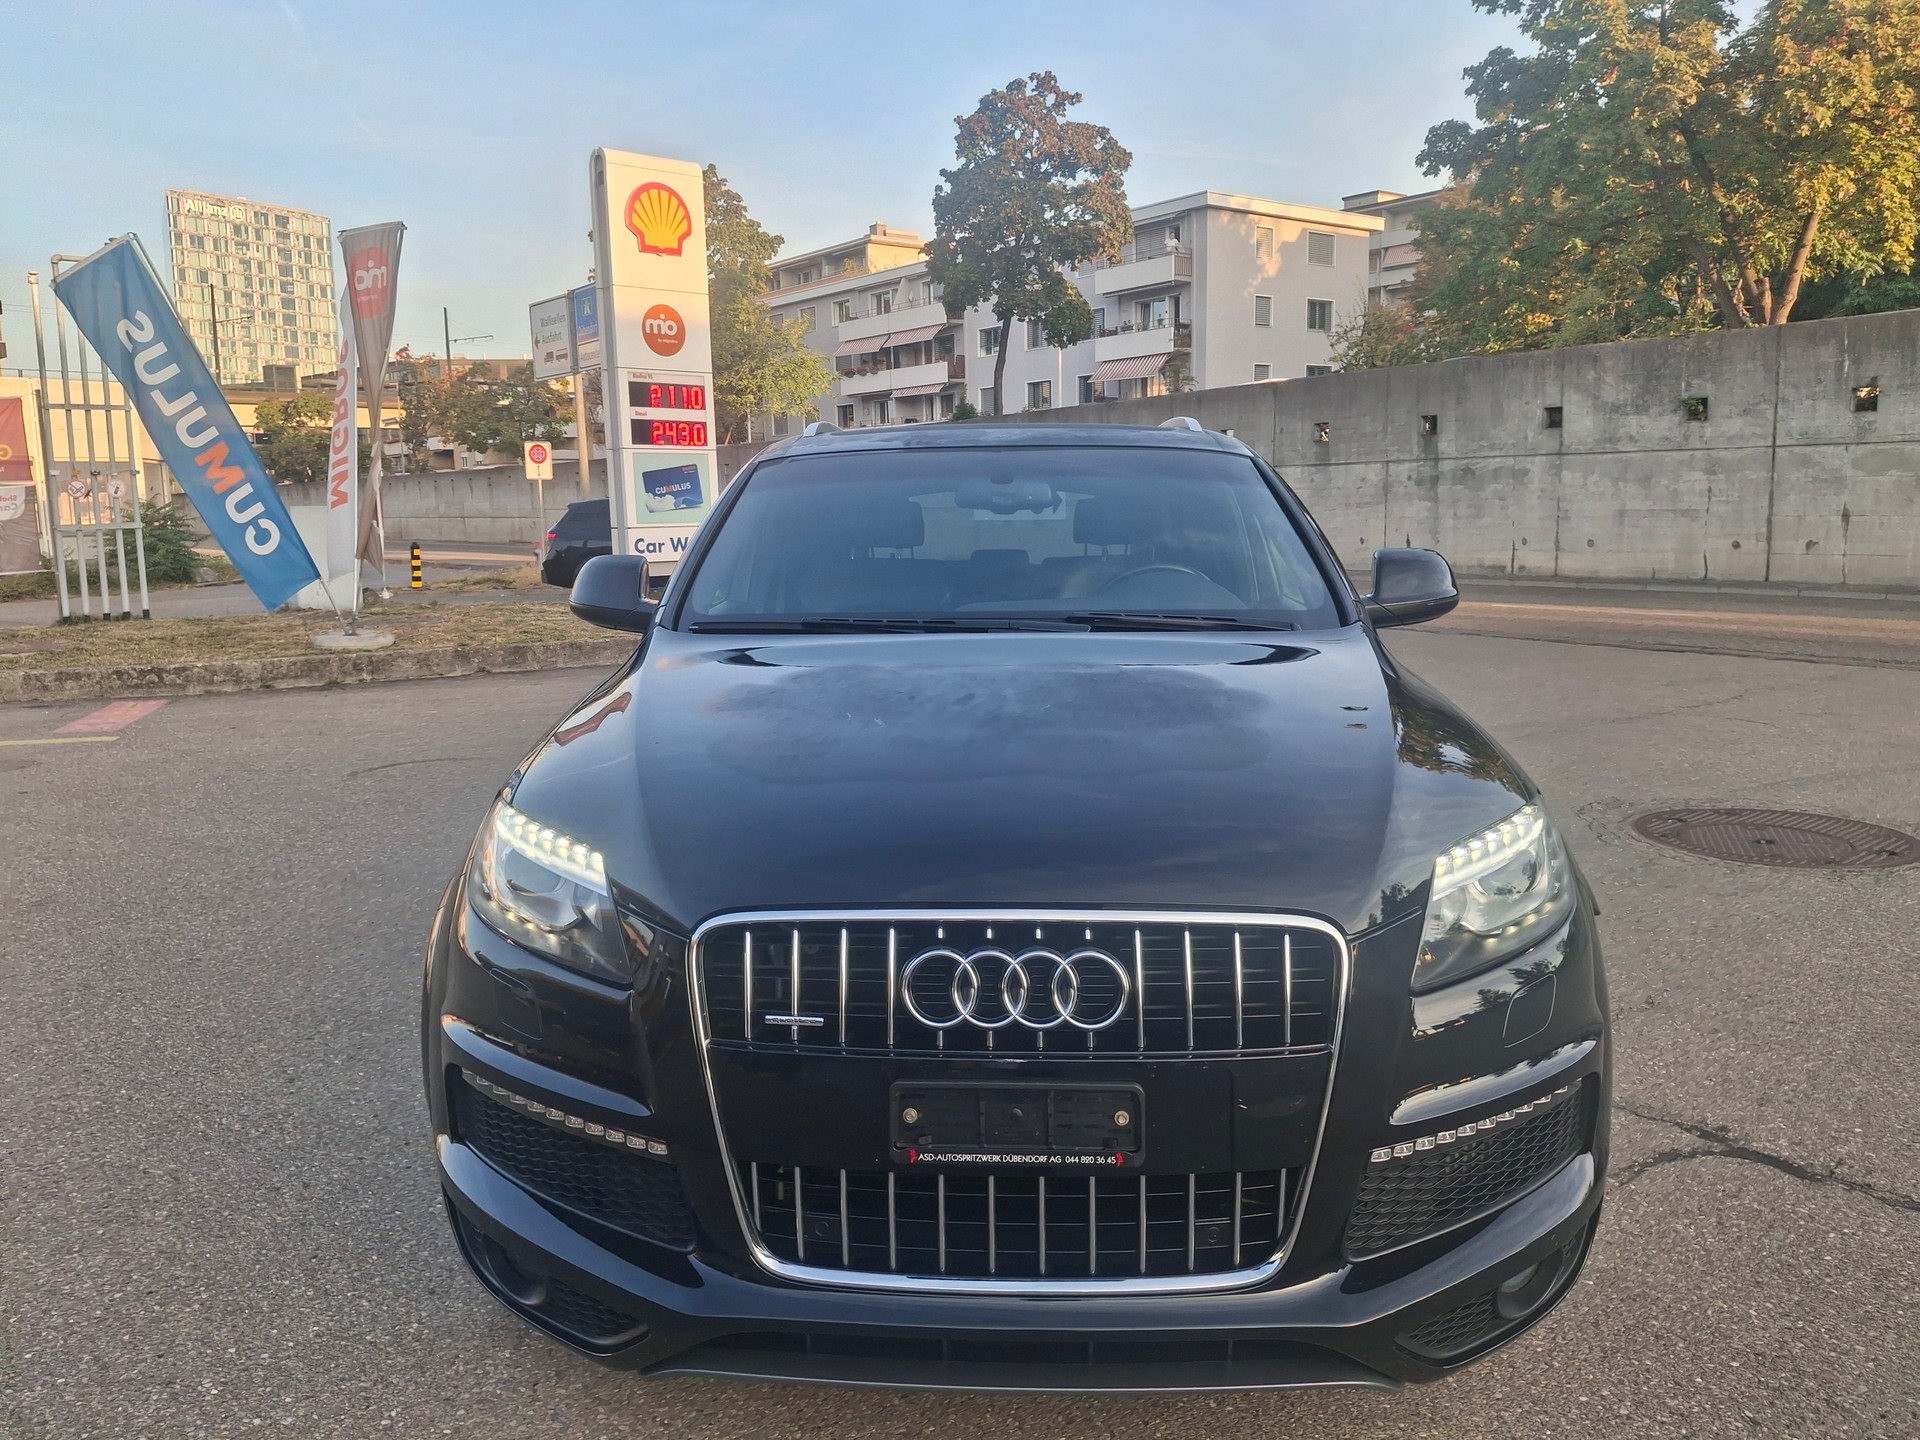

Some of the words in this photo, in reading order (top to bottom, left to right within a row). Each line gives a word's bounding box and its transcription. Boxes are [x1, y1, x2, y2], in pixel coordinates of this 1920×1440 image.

[184, 199, 228, 218] Allianz
[645, 313, 678, 336] mio
[655, 482, 691, 494] CUMULUS
[634, 538, 665, 554] Car
[669, 537, 689, 552] W
[918, 1153, 1002, 1163] ASD-AUTOSPRITZWERK
[1002, 1154, 1048, 1163] DÜBENDORF
[1049, 1156, 1062, 1164] AG
[1065, 1156, 1079, 1164] 044
[1096, 1156, 1105, 1164] 36
